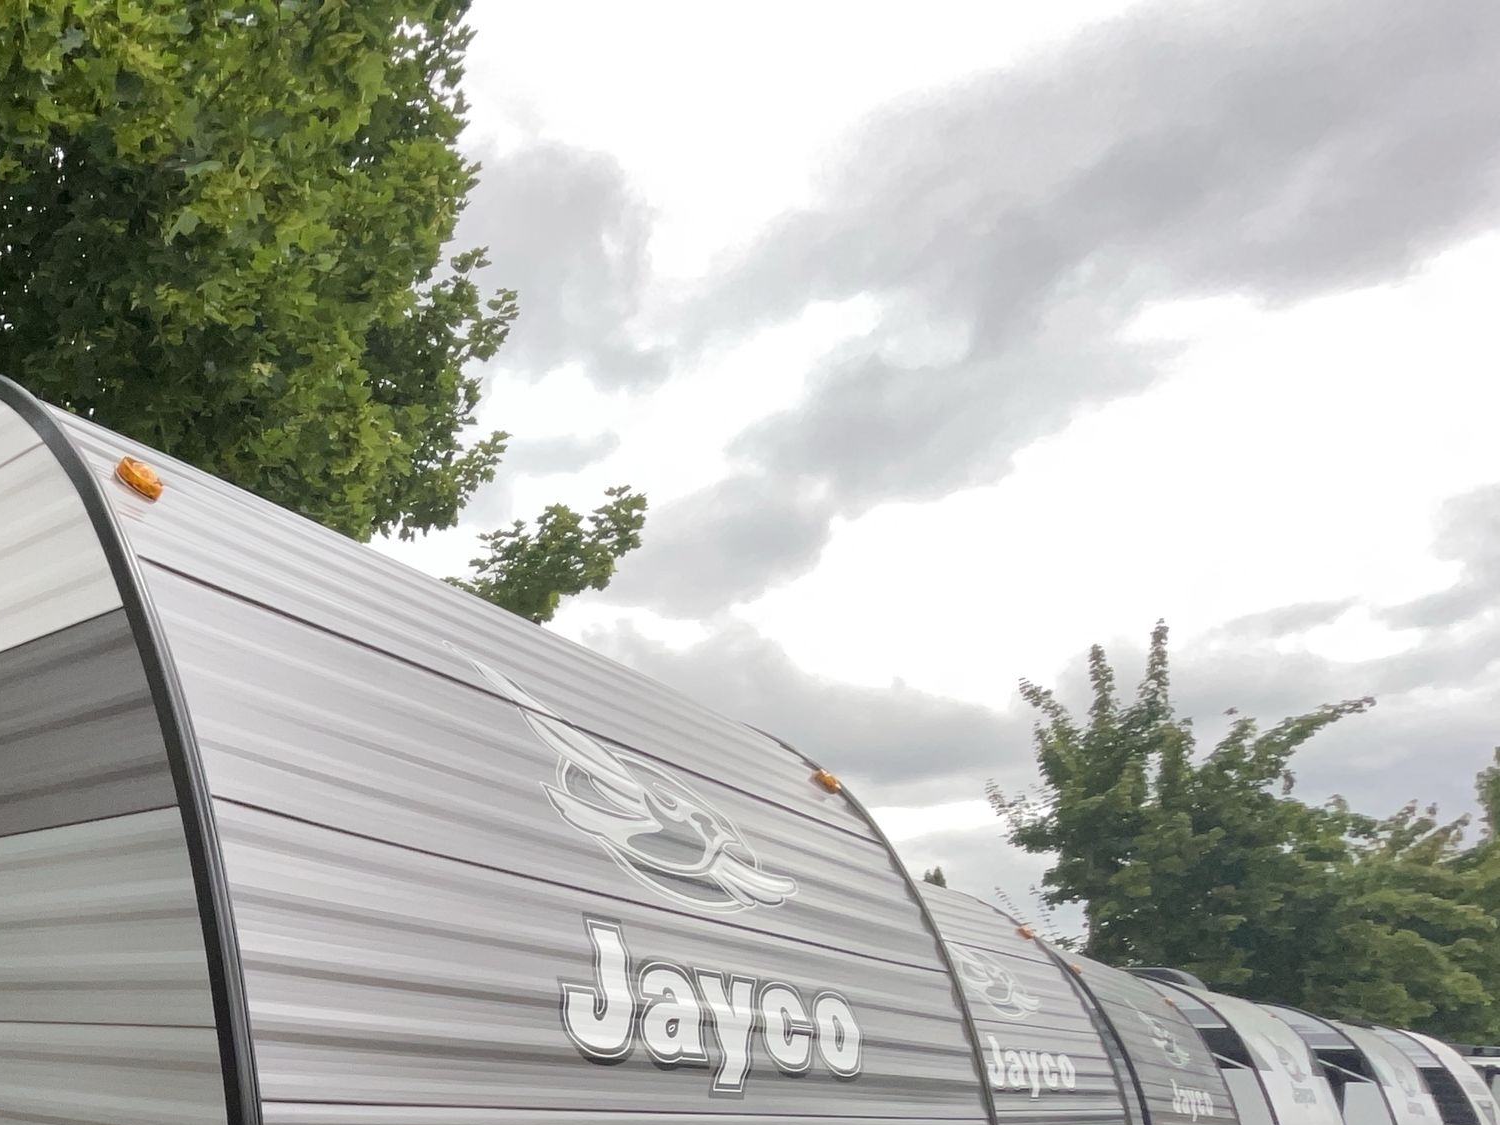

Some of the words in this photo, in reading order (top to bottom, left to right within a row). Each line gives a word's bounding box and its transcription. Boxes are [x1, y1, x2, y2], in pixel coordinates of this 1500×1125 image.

[558, 914, 863, 1098] Jayco
[986, 1034, 1077, 1101] Jayco
[1170, 1079, 1213, 1122] Jayco
